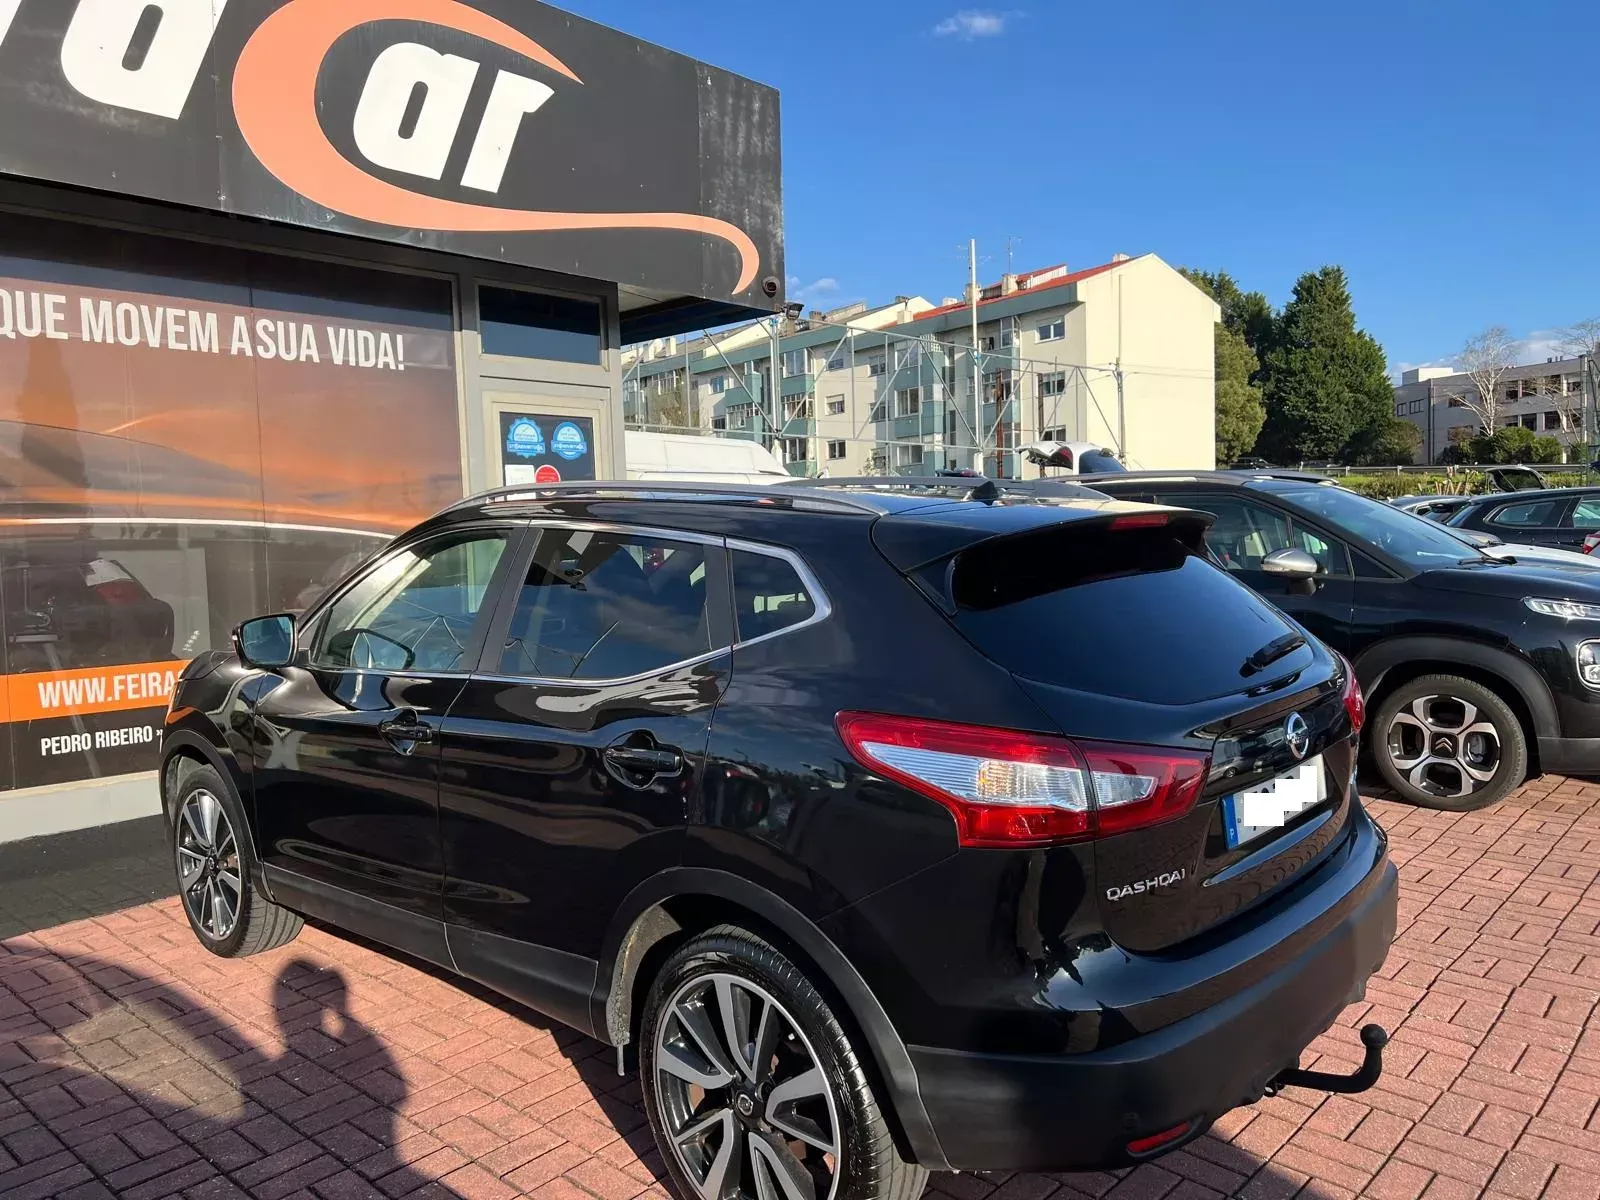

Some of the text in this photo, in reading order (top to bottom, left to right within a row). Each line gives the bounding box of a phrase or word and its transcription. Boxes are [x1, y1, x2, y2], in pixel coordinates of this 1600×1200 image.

[0, 288, 69, 339] QUE
[80, 298, 219, 354] MOVEM
[327, 327, 405, 371] VIDA!
[41, 725, 153, 756] PEDRO RIBEIRO
[1106, 868, 1186, 901] QASHQAI
